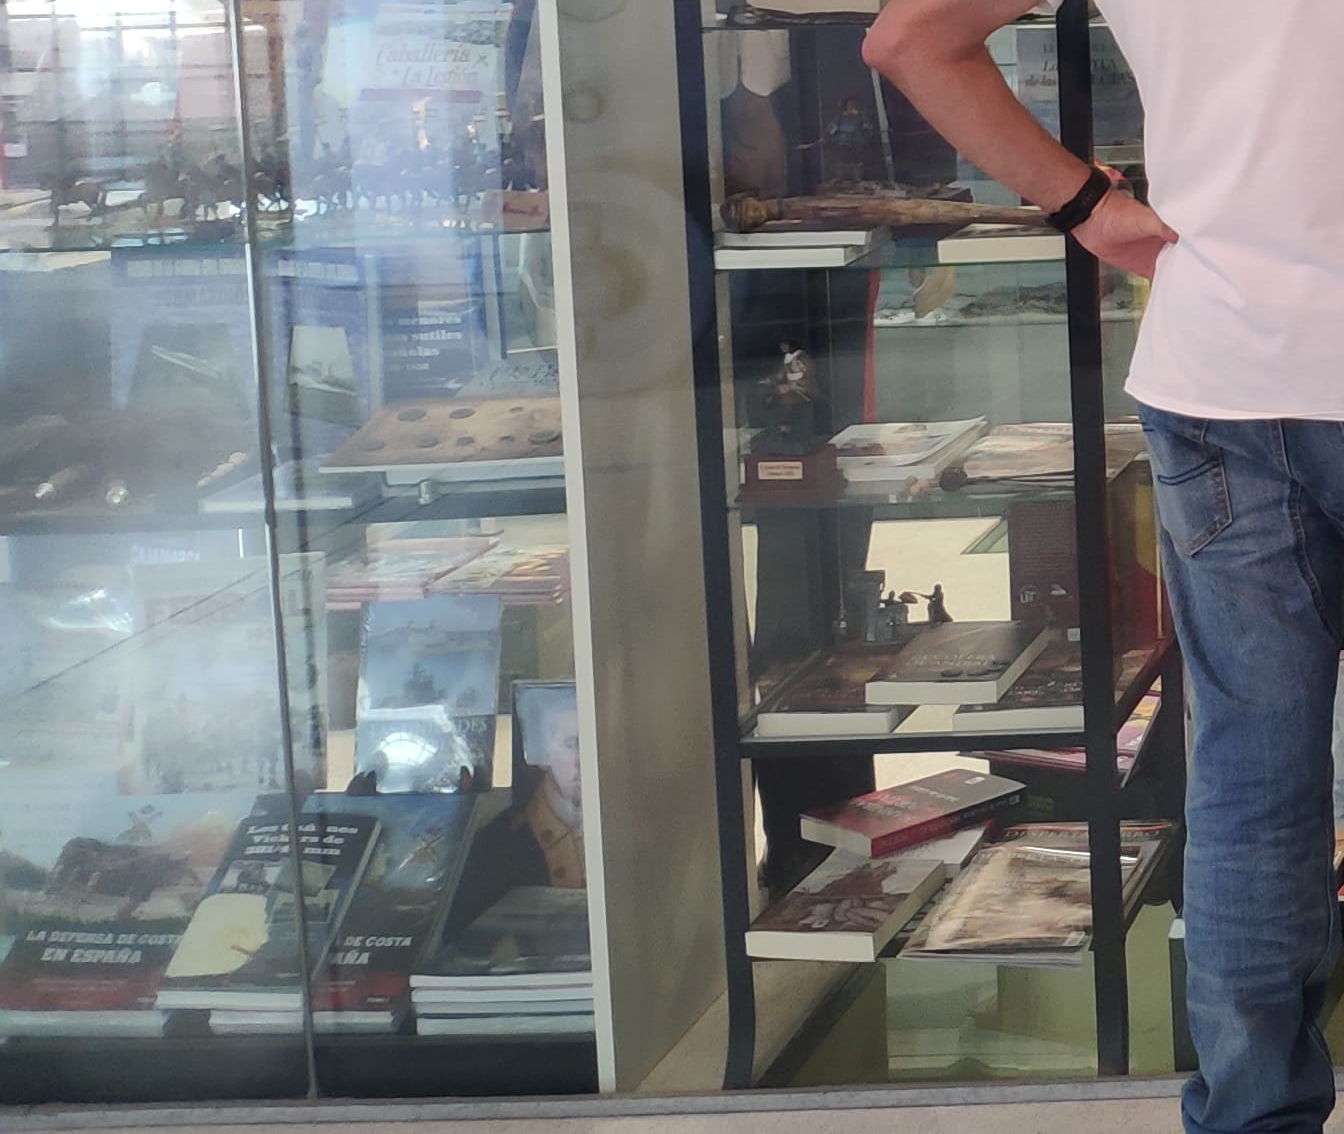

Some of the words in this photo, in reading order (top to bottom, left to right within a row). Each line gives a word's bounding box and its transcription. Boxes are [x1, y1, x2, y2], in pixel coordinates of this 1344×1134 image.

[322, 835, 345, 845] de
[25, 929, 46, 942] LA
[116, 933, 138, 945] DE
[344, 935, 364, 947] DE
[365, 935, 414, 947] COSTA
[40, 947, 69, 962] EN
[70, 947, 142, 964] ESPAÑA
